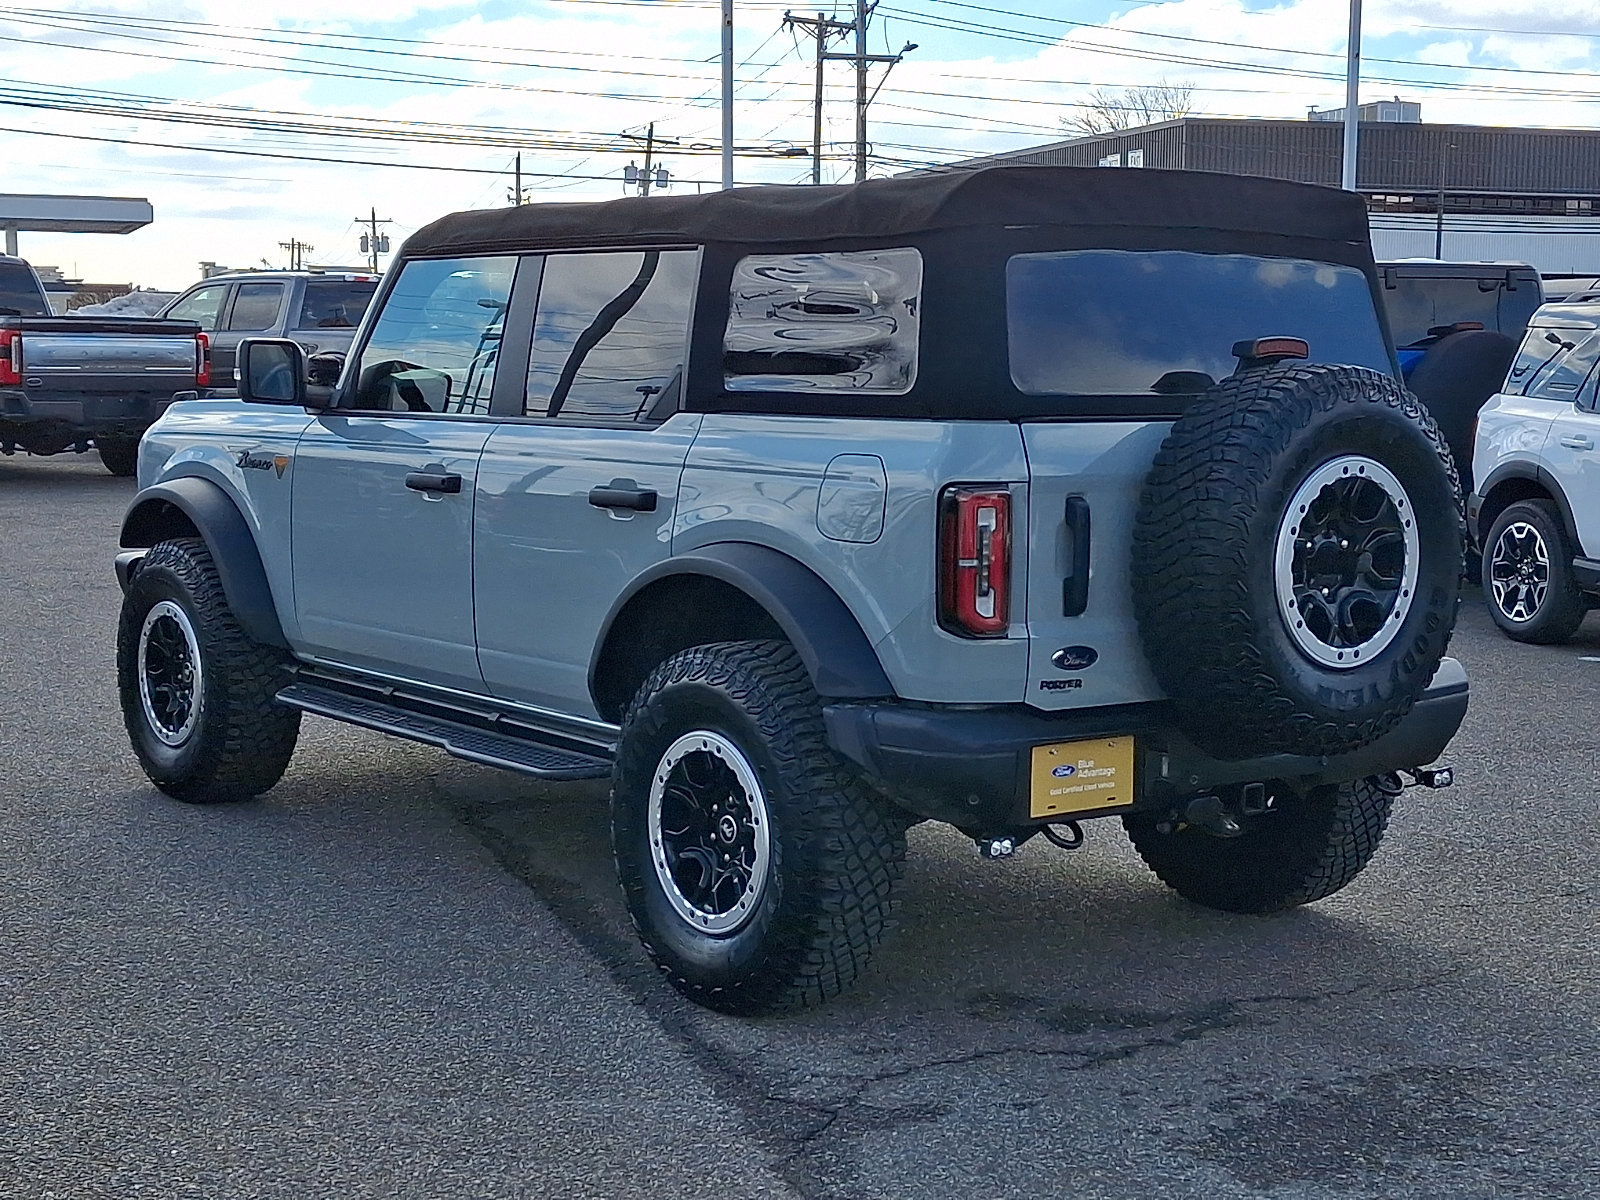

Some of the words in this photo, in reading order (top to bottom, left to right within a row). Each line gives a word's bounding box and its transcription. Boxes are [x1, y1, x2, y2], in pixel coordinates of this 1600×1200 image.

[235, 449, 274, 471] Bronco
[1077, 767, 1116, 778] Advantage
[1062, 785, 1084, 794] Certified
